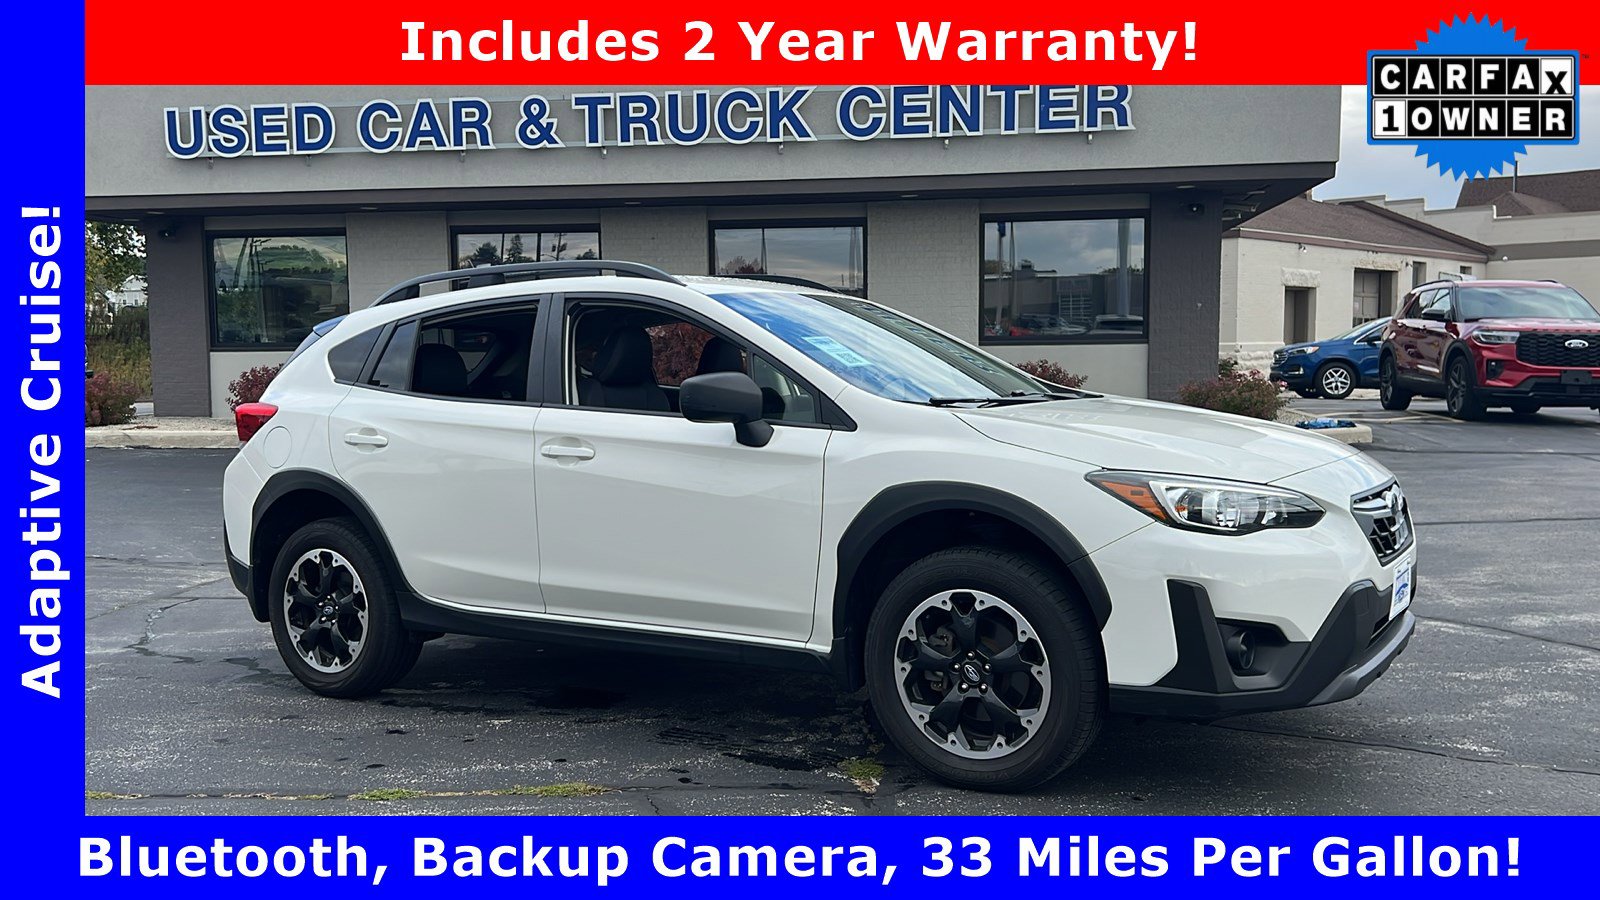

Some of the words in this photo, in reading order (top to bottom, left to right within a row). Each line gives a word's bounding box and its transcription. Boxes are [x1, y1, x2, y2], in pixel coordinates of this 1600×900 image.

[164, 103, 336, 159] USED
[357, 97, 496, 154] CAR
[515, 94, 566, 149] &
[572, 85, 817, 146] TRUCK
[836, 84, 1136, 141] CENTER
